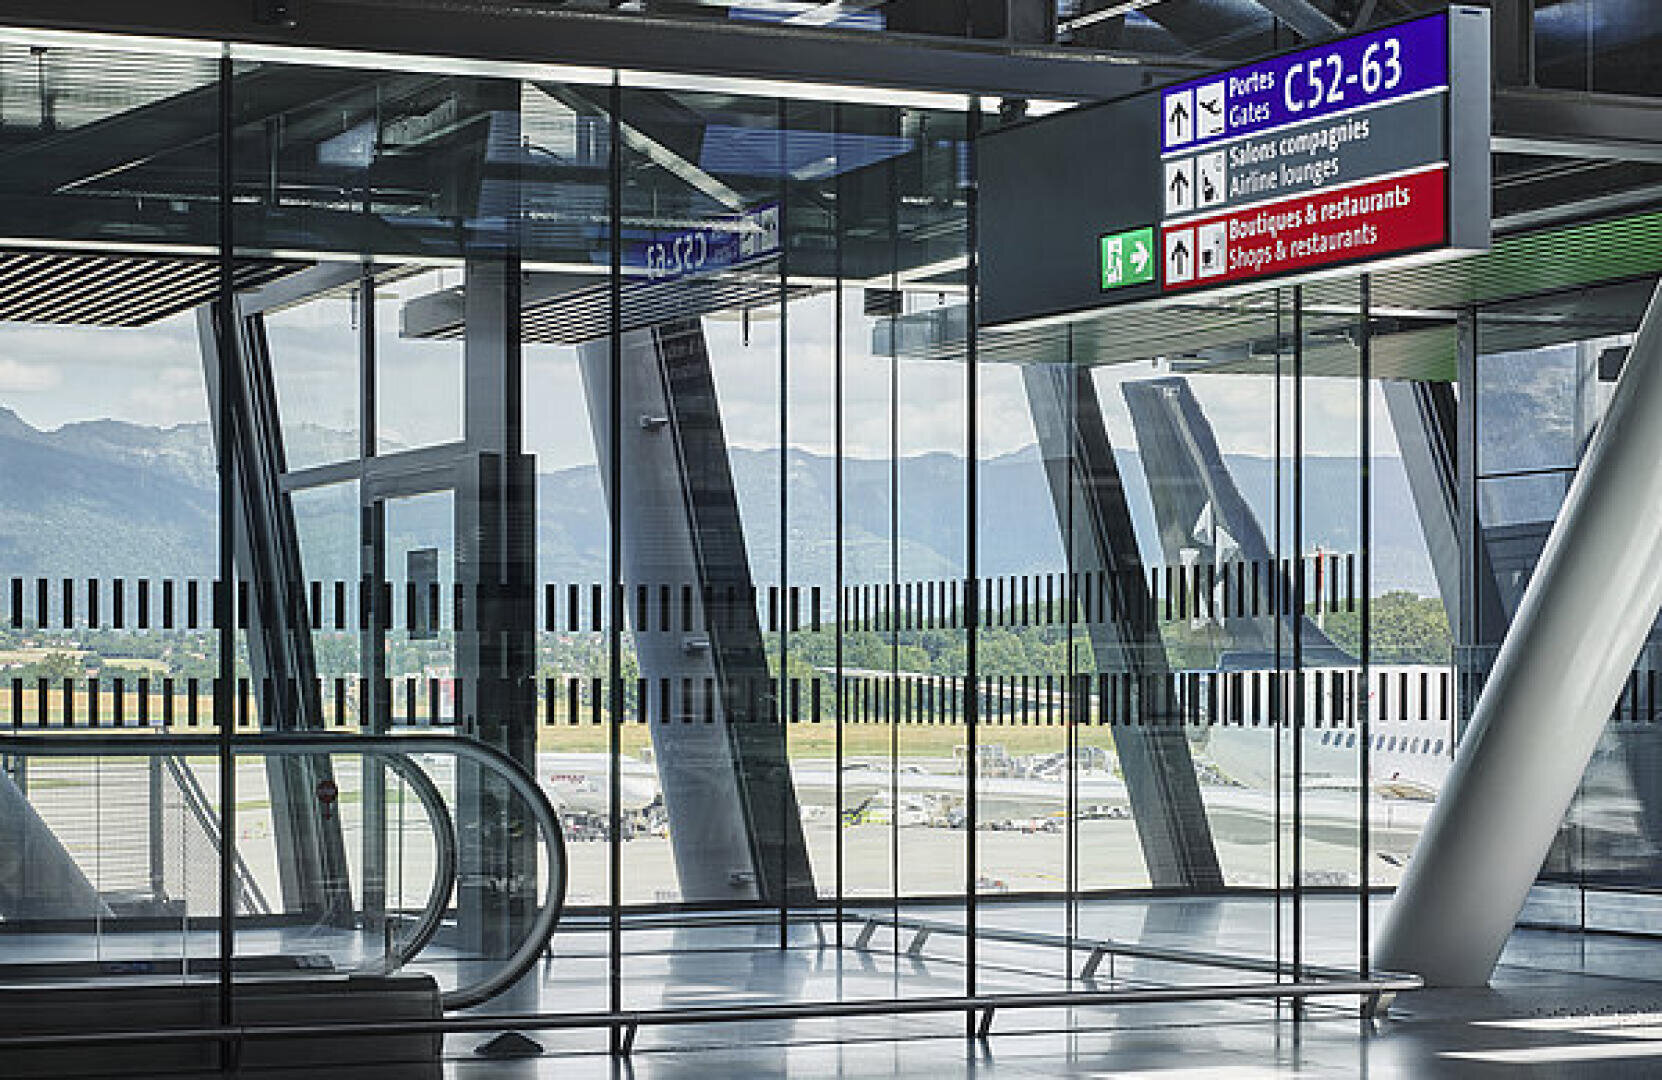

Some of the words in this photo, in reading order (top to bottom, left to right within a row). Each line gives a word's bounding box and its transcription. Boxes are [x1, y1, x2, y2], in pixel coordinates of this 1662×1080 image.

[1229, 71, 1275, 98] Portes
[1284, 38, 1401, 112] C52-63
[1229, 102, 1270, 128] Gates
[1229, 141, 1277, 168] Salons
[1280, 119, 1370, 156] compagnies
[1229, 171, 1278, 198] Airline
[1280, 158, 1339, 187] lounges
[1229, 210, 1302, 241] Boutiques
[1305, 202, 1317, 225] &
[1321, 185, 1411, 222] restaurants
[1229, 246, 1272, 272] Shops
[1274, 240, 1287, 261] &
[1290, 221, 1378, 258] restaurants
